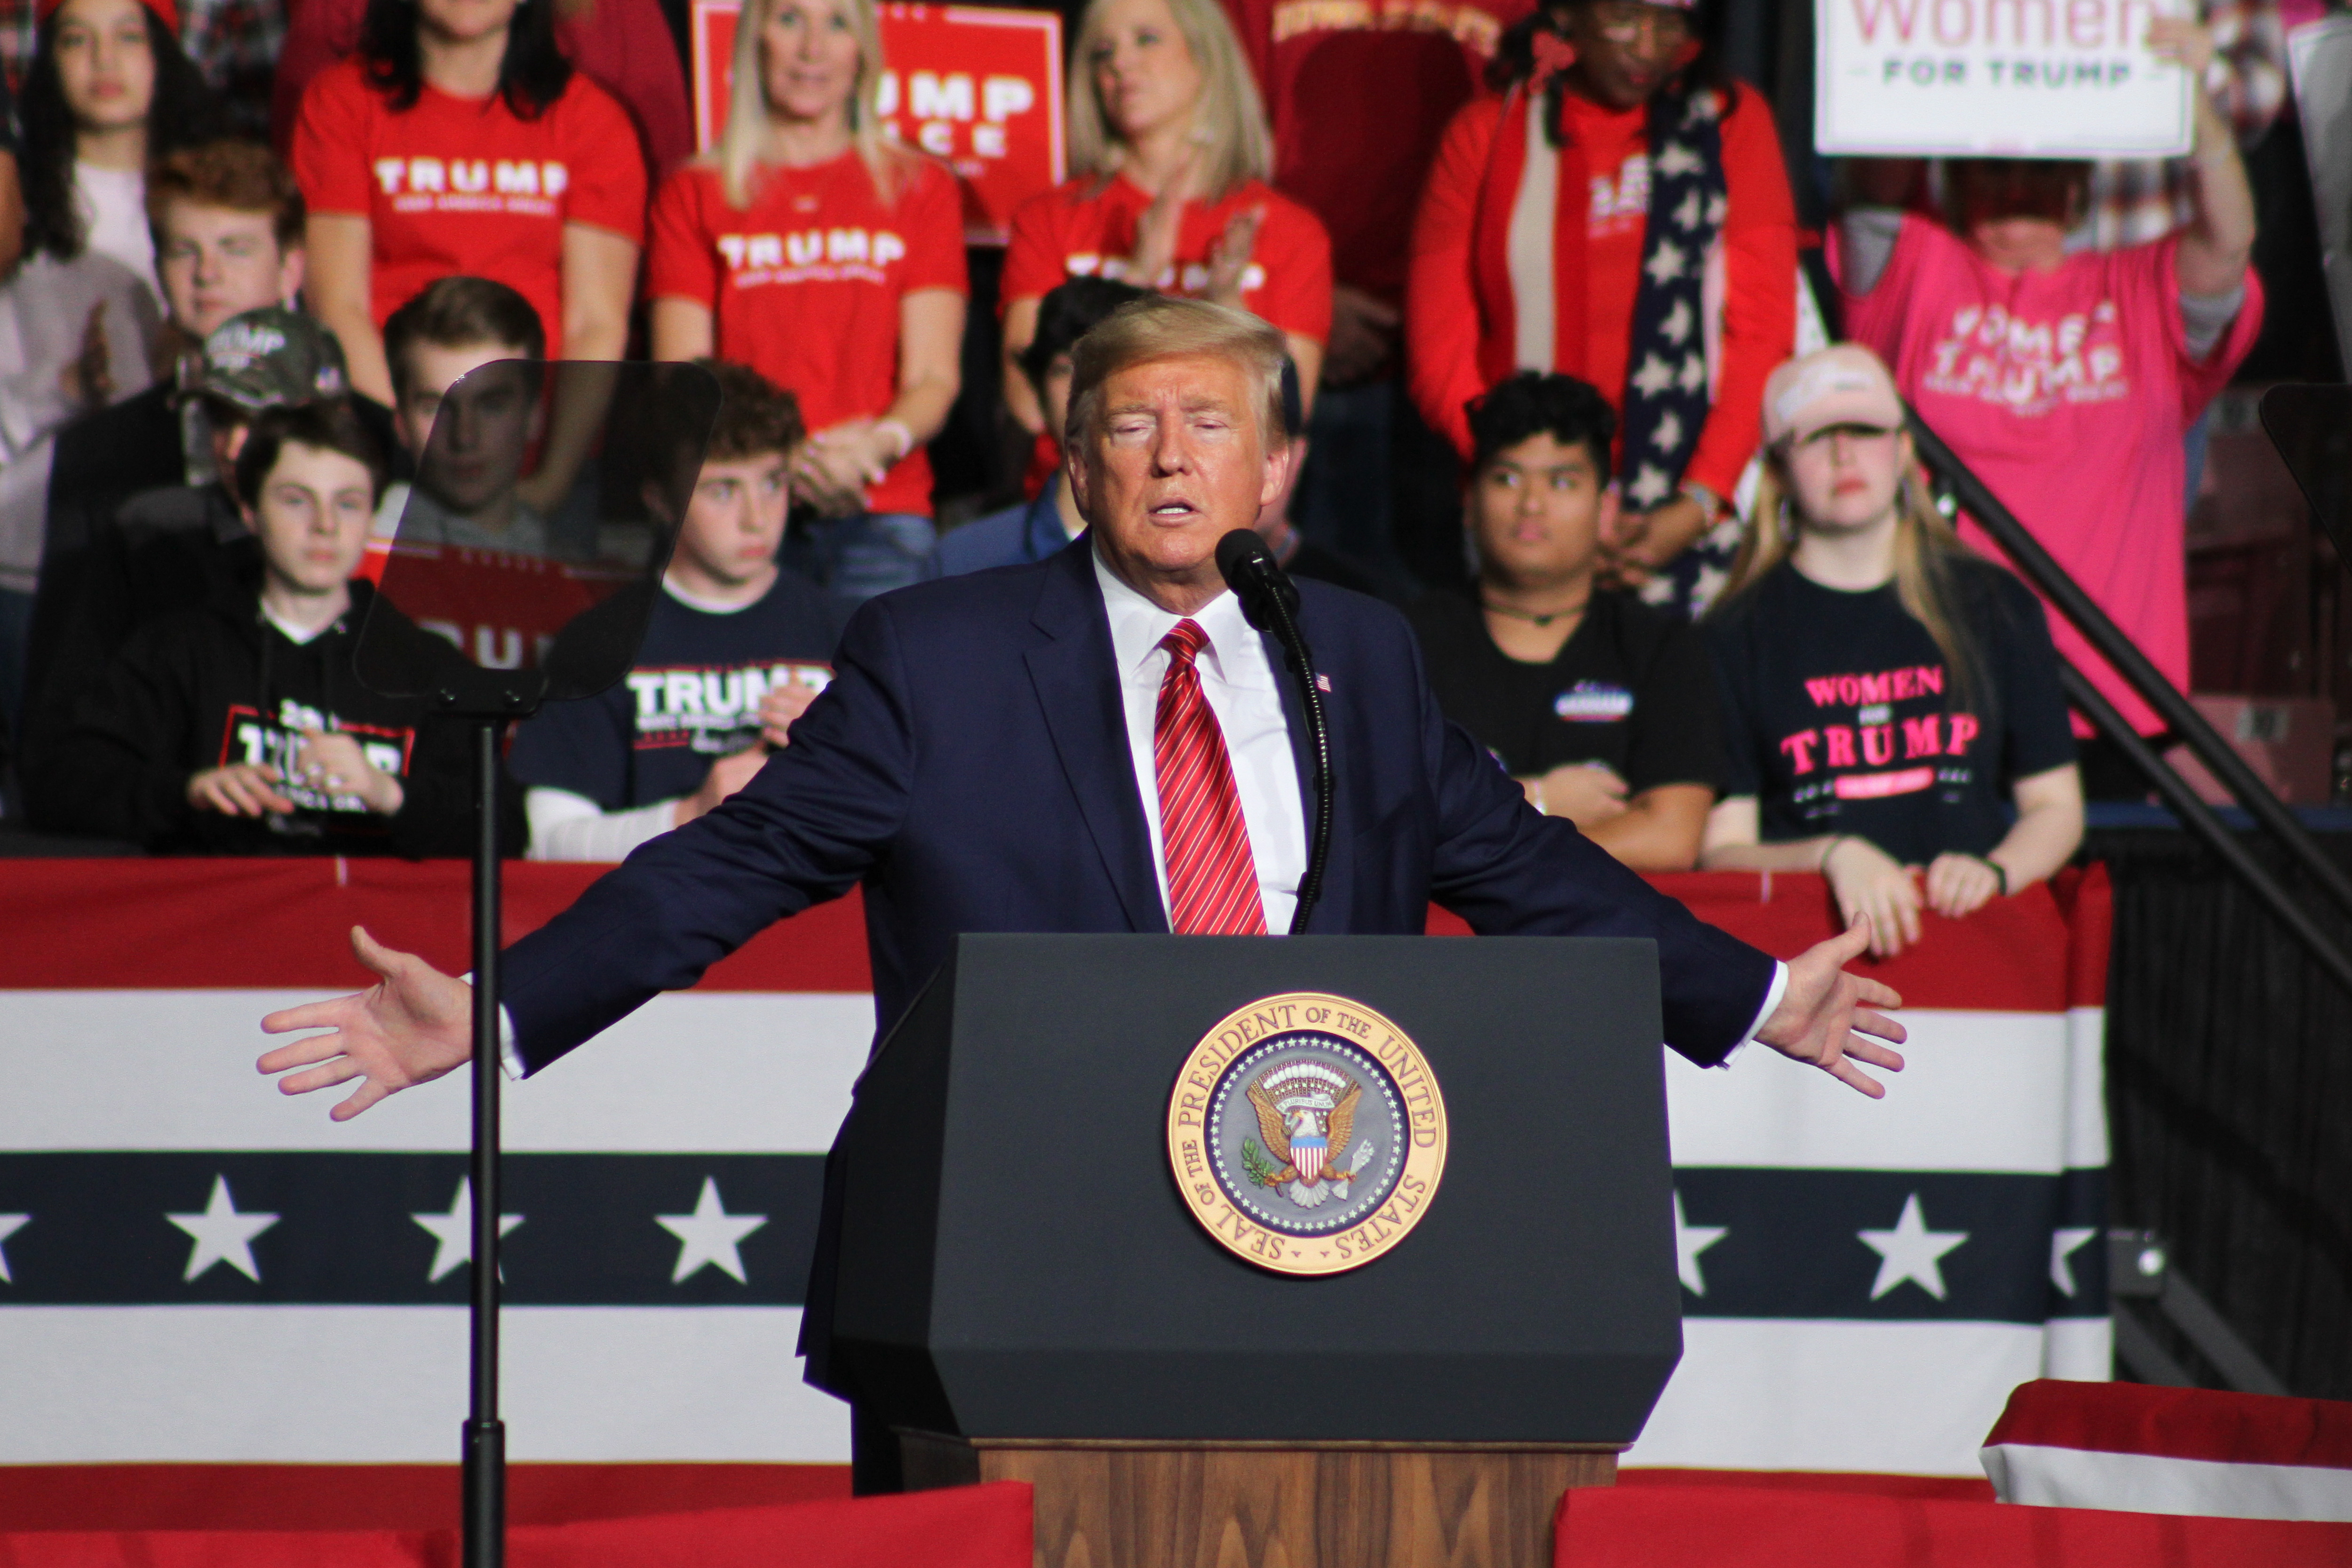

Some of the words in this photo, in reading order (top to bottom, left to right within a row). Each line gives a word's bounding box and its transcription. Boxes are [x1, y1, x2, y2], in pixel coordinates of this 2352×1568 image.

[1882, 58, 1967, 87] FOR
[1986, 59, 2130, 88] TRUMP
[374, 157, 568, 197] TRUMP
[717, 227, 906, 270] TRUMP
[1804, 664, 1943, 707] WOMEN
[1780, 713, 1980, 775] TRUMP
[1305, 1007, 1331, 1024] OF
[1337, 1011, 1372, 1039] THE
[1178, 1004, 1296, 1128] PRESIDENT
[1378, 1035, 1437, 1148] UNITED
[1182, 1139, 1203, 1178] THE
[1194, 1182, 1216, 1205] OF
[1216, 1203, 1285, 1259] SEAL
[1335, 1175, 1426, 1259] STATES
